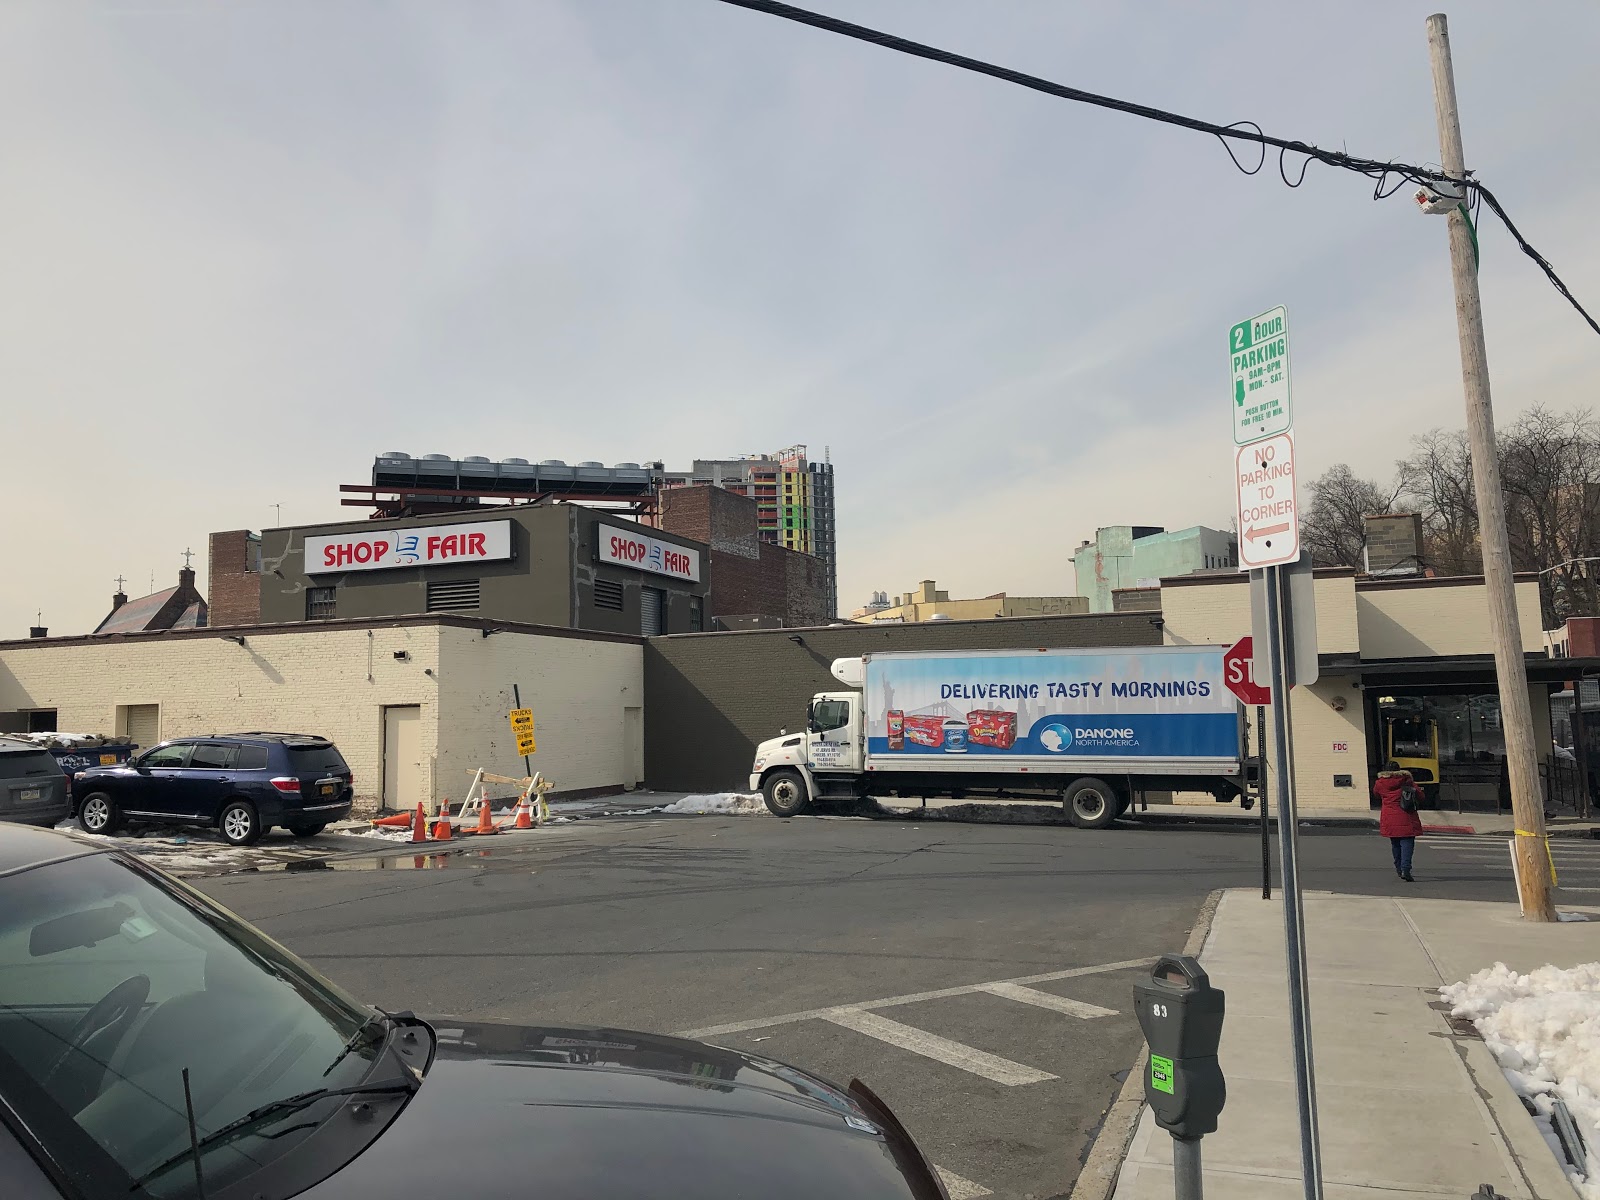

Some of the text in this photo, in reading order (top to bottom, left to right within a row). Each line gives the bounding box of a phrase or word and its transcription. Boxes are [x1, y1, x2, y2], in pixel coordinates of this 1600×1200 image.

[1234, 316, 1283, 350] 2 HOUR
[1233, 338, 1285, 373] PARKING
[1248, 359, 1281, 380] 9AM-8PM
[1245, 399, 1279, 416] PUSH BUTTON
[1241, 416, 1251, 427] FOR
[1252, 412, 1264, 423] FREE
[1255, 445, 1275, 464] NO
[1240, 461, 1292, 487] PARKING
[1258, 485, 1275, 500] TO
[1242, 499, 1293, 523] CORNER
[323, 532, 487, 567] SHOP FAIR
[610, 536, 691, 576] SHOP FAIR
[1228, 657, 1254, 684] ST
[940, 680, 1211, 700] DELIVERING TASTY MORNINGS
[511, 709, 532, 717] TRUCKS
[1333, 743, 1348, 751] FDC
[1153, 1003, 1168, 1018] 83
